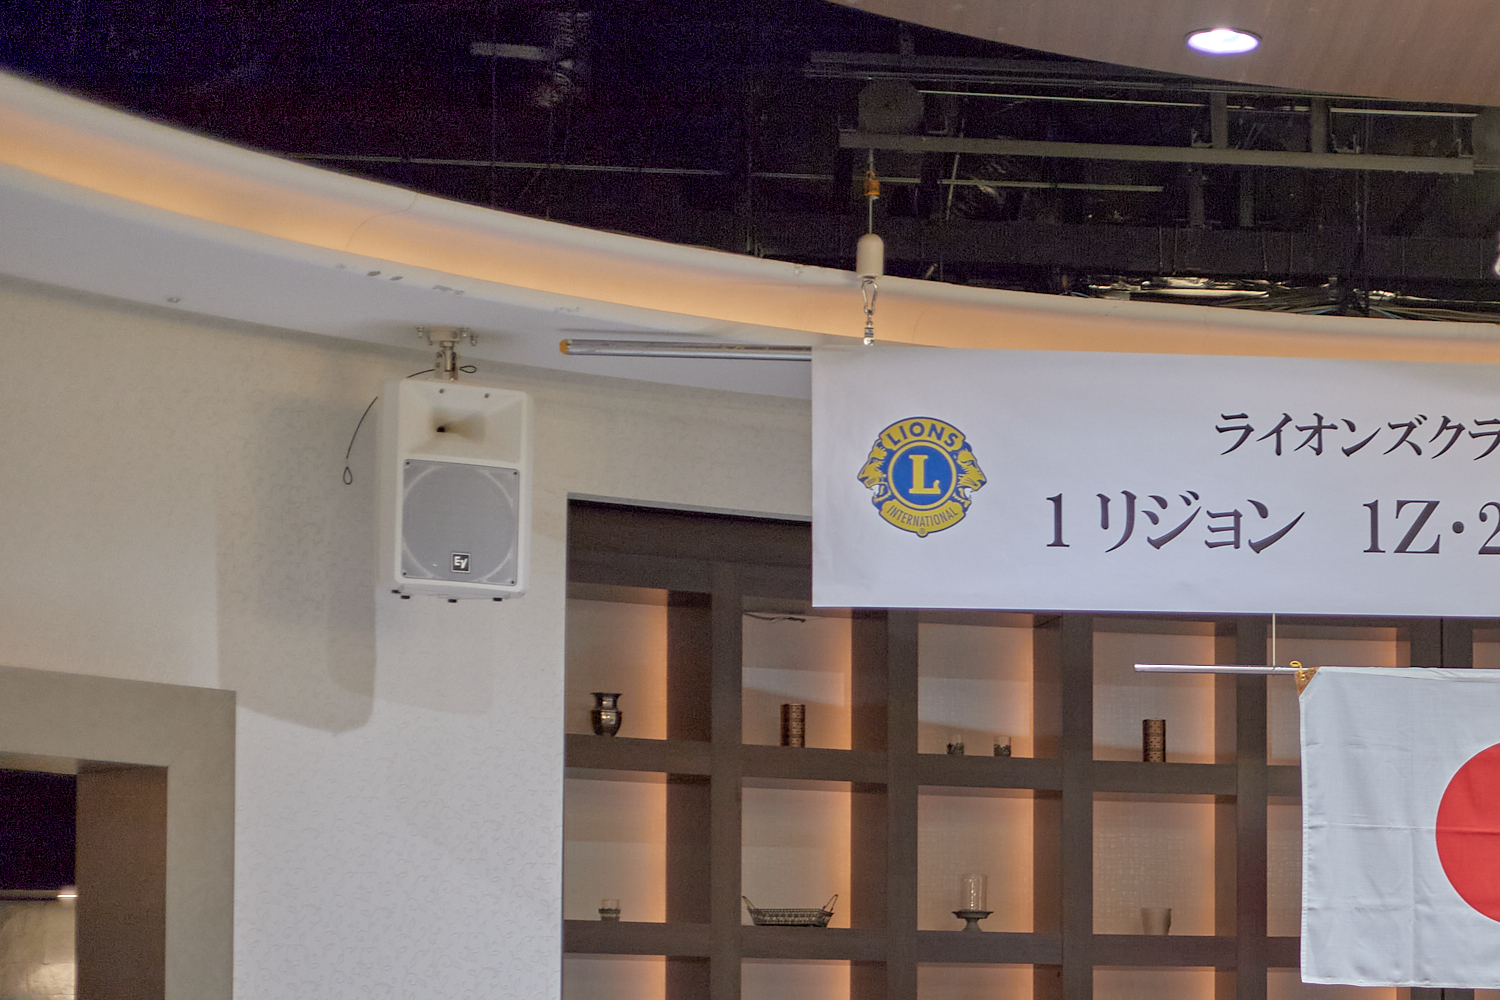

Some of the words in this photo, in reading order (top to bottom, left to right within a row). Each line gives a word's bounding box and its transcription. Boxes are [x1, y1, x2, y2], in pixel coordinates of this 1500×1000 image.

[885, 421, 959, 448] LIONS
[908, 453, 942, 495] L
[886, 504, 959, 528] INTERNATIONAL
